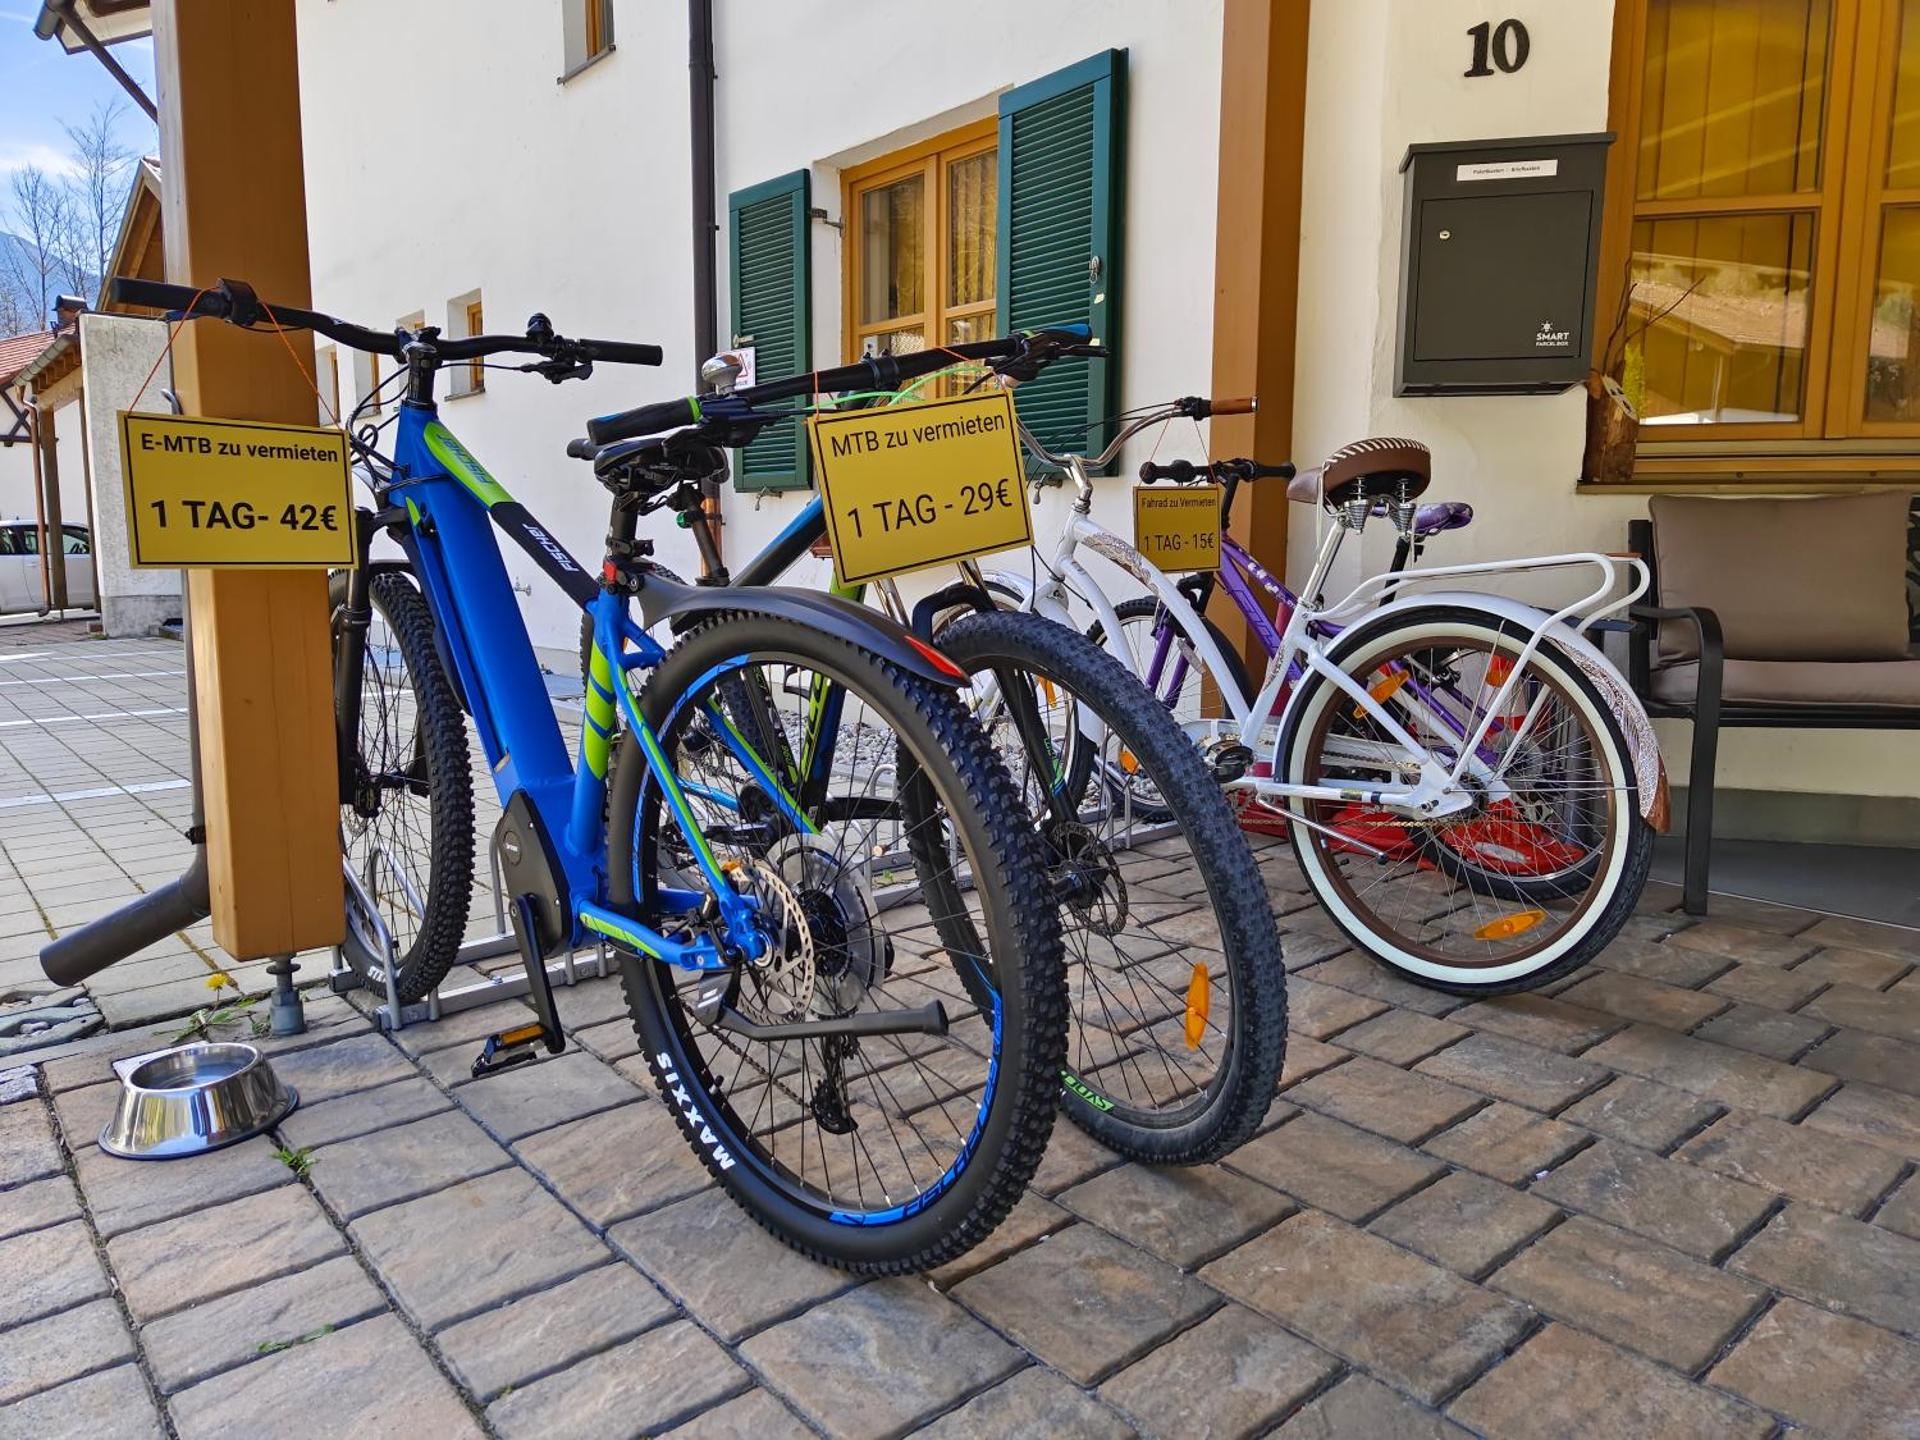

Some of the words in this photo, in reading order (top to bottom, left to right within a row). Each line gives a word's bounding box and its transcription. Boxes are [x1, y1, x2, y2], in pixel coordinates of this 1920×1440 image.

[1463, 18, 1530, 78] 10
[1536, 332, 1570, 341] SMART
[141, 433, 212, 454] E-MTB
[218, 442, 241, 456] zu
[246, 444, 338, 462] vermieten
[831, 430, 880, 457] MTB
[885, 430, 909, 449] zu
[913, 414, 1005, 443] vermieten
[151, 500, 167, 528] 1
[182, 500, 269, 530] TAG-
[279, 504, 338, 531] 42€
[848, 508, 863, 538] 1
[873, 494, 937, 532] TAG
[960, 478, 1013, 516] 29€
[1169, 500, 1178, 508] zu
[1144, 536, 1149, 551] 1
[1155, 534, 1181, 551] TAG
[1193, 532, 1215, 549] 15€
[656, 1052, 737, 1170] MAXXIS
